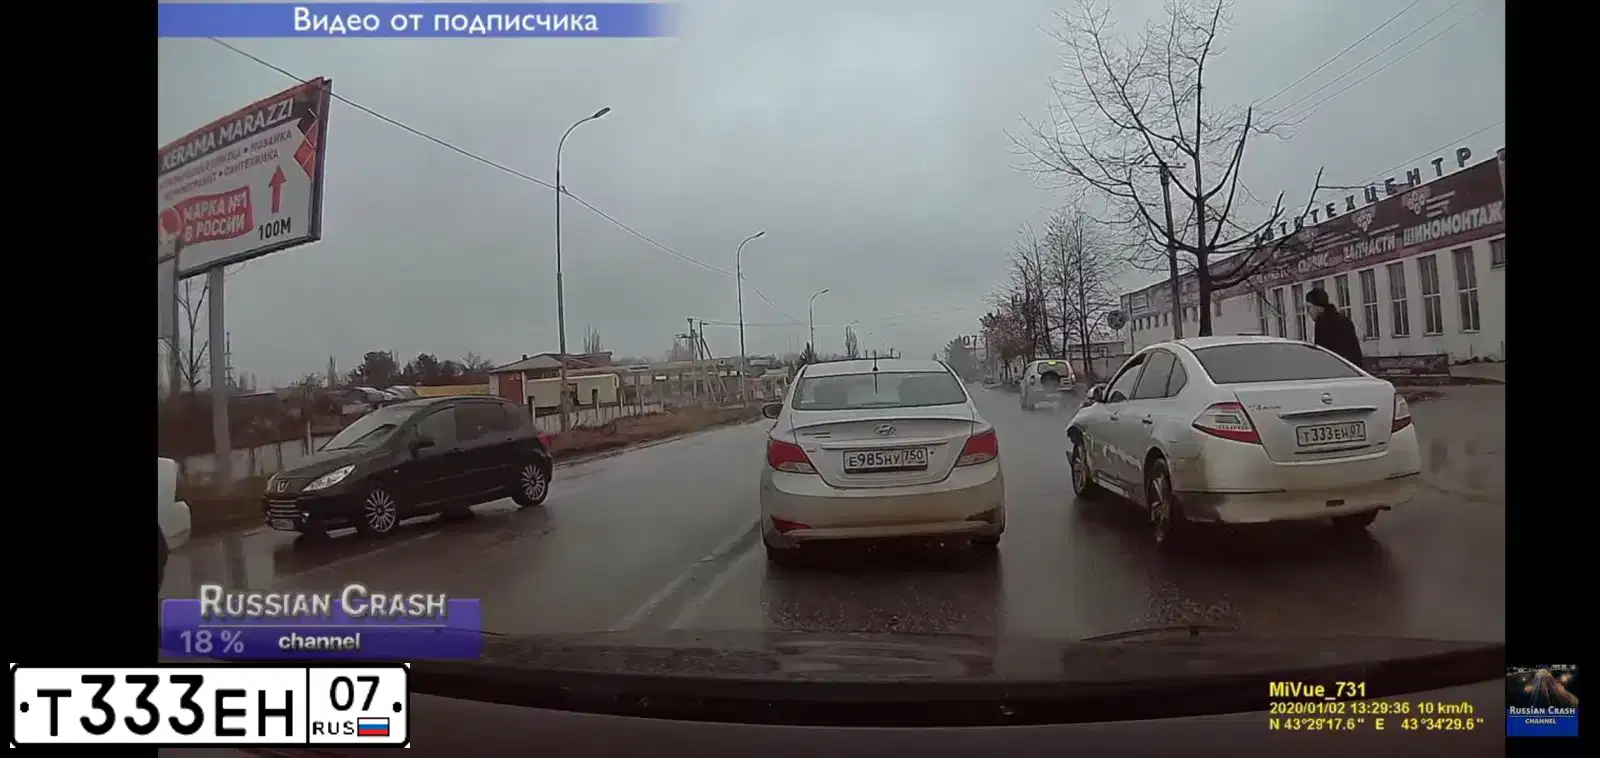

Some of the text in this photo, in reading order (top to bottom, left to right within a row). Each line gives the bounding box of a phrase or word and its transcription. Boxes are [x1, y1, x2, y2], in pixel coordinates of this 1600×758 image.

[163, 133, 218, 171] KERAMA
[218, 98, 294, 144] MARAZZI
[182, 198, 225, 220] МАРКА
[184, 213, 245, 242] В РОССИИ
[1343, 231, 1396, 262] ЗАПЧАСТИ
[1403, 201, 1505, 246] ШИНОМОНТАЖ
